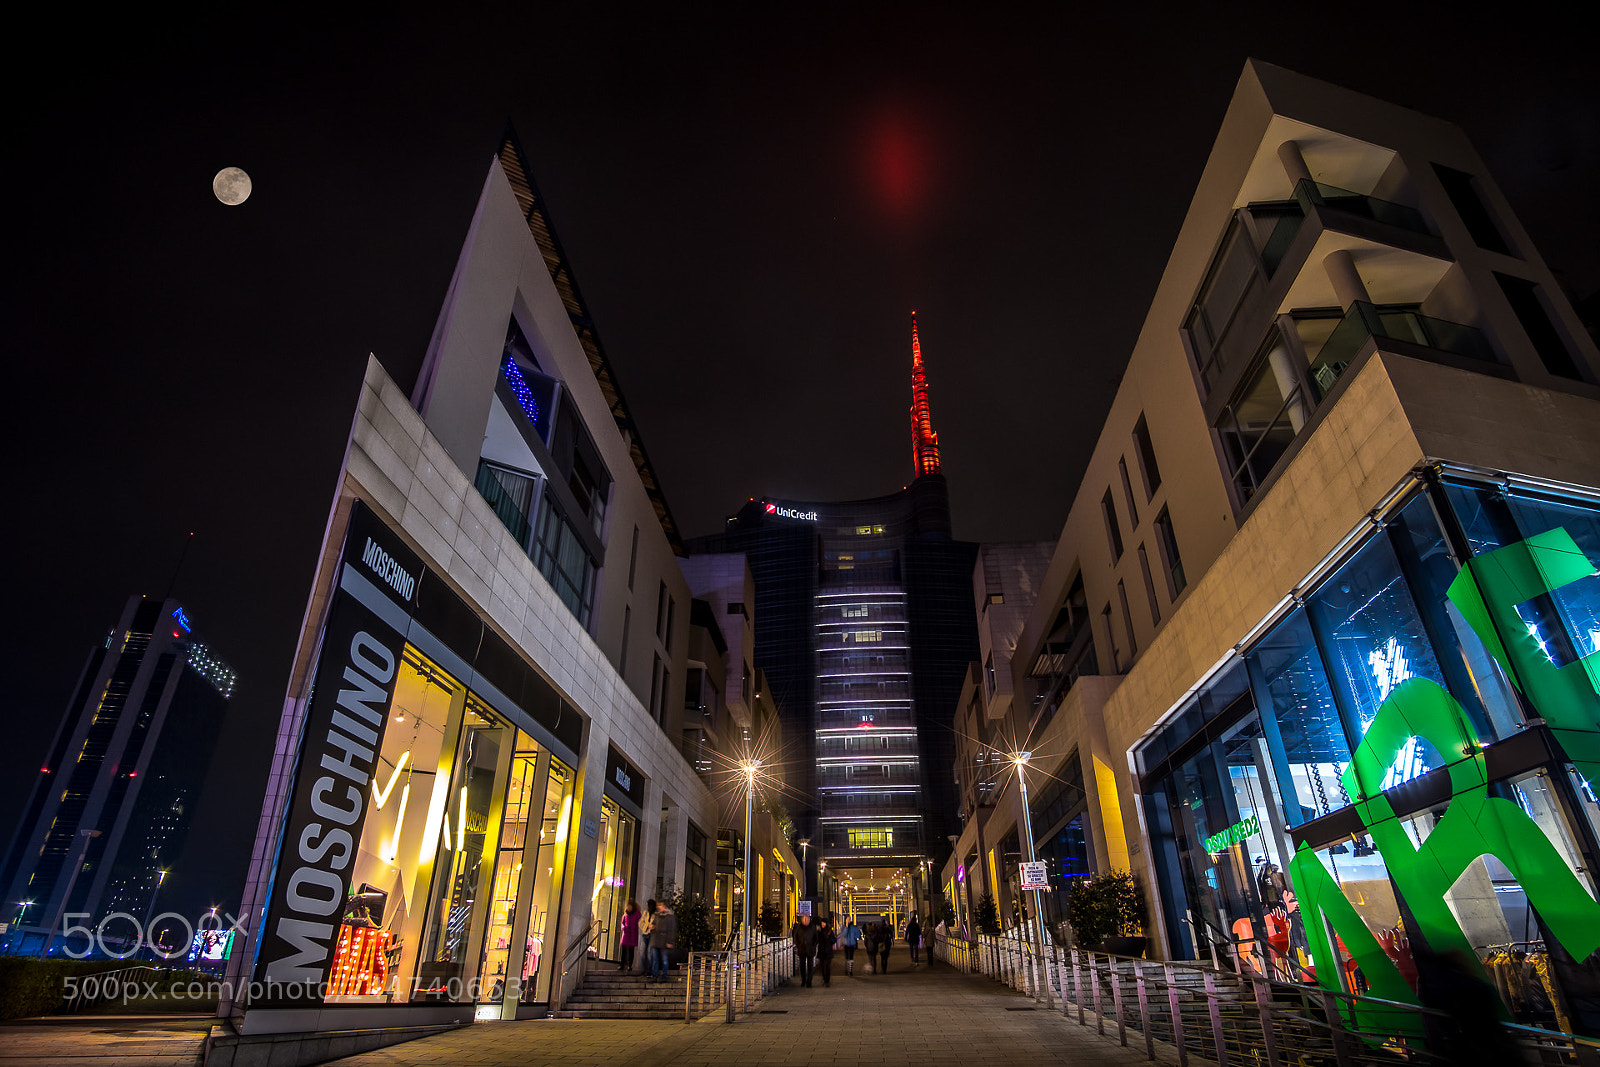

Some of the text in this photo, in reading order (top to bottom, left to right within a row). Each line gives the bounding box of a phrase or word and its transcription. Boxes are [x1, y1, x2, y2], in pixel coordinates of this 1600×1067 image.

[776, 506, 818, 520] UniCredit
[362, 536, 414, 601] MOSCHINO
[265, 631, 395, 984] MOSCHINO
[1205, 815, 1260, 855] DSQUARED2
